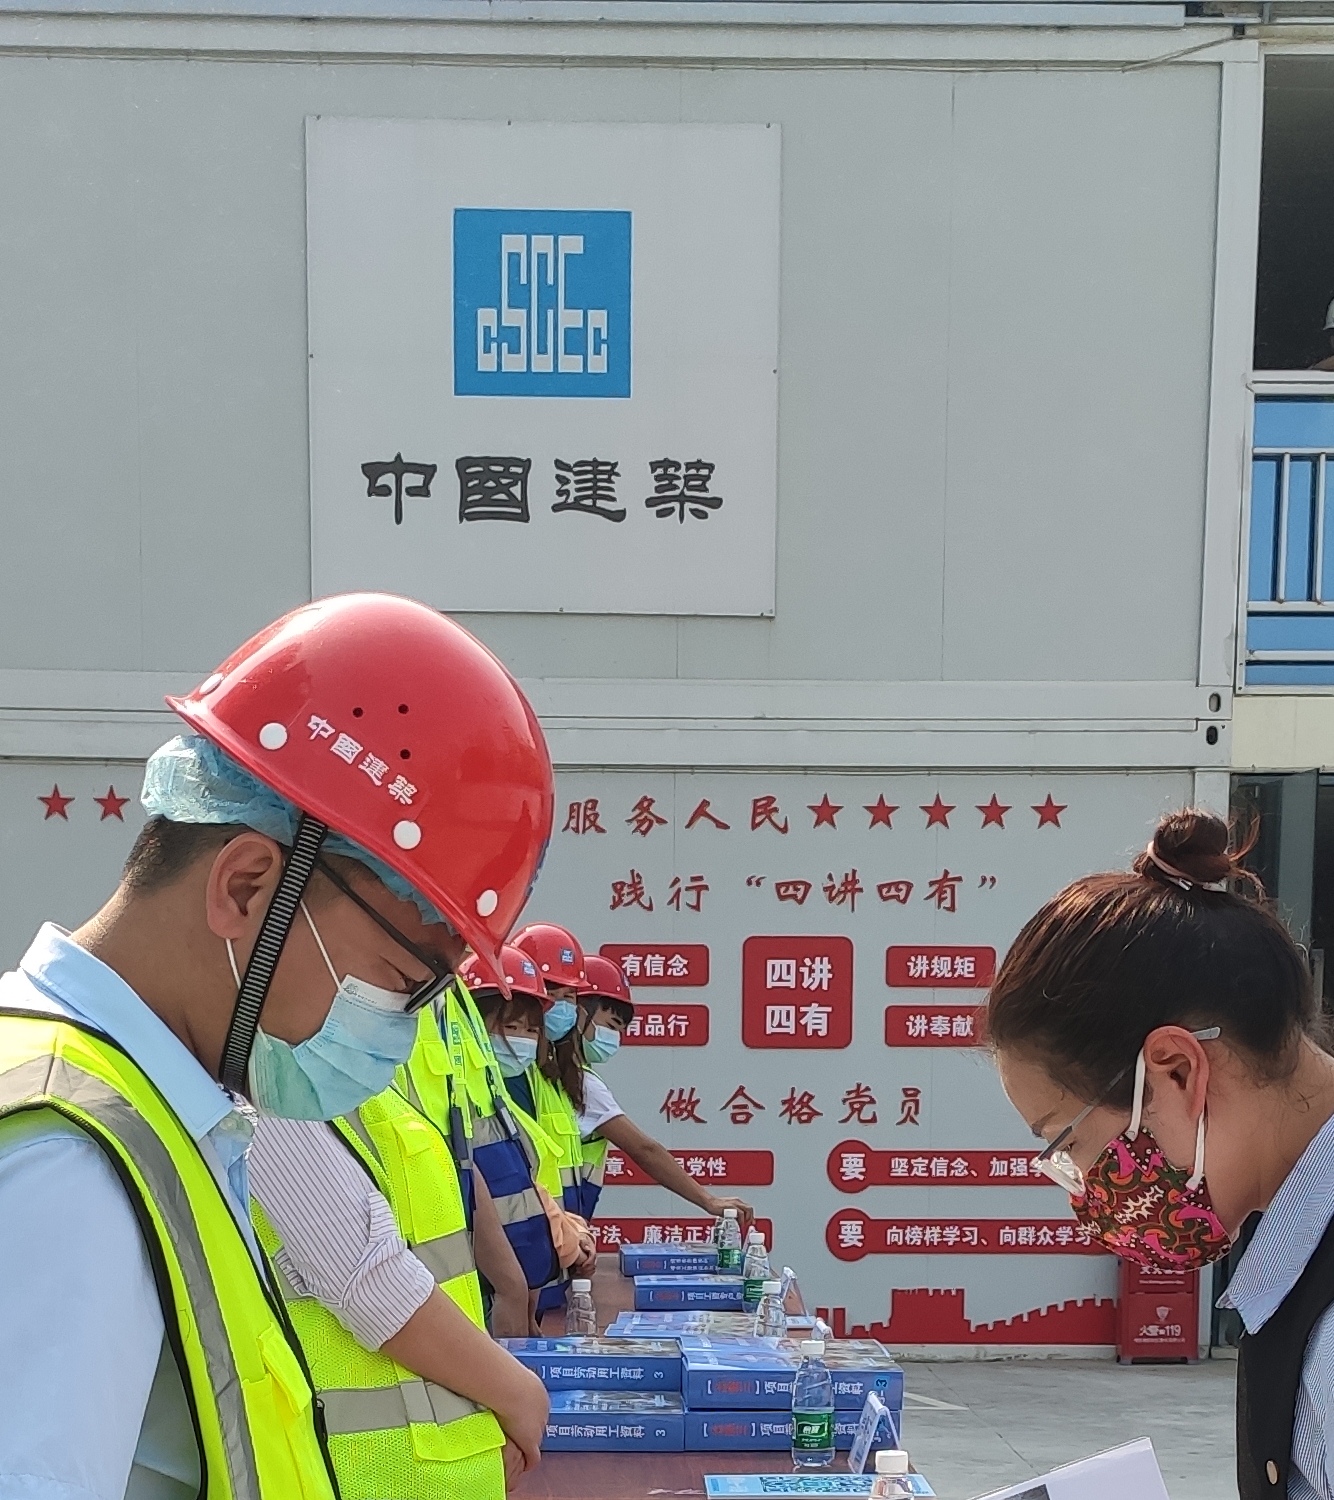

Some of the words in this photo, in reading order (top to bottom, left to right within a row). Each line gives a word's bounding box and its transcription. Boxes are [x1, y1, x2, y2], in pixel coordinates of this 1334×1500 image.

[621, 954, 689, 977] 有信念
[766, 956, 833, 991] 四讲
[907, 956, 976, 979] 讲规矩
[766, 1003, 833, 1038] 四有
[906, 1014, 975, 1038] 讲奉献
[660, 1083, 922, 1126] 做合格党员
[841, 1153, 866, 1180] 要
[839, 1221, 865, 1248] 要
